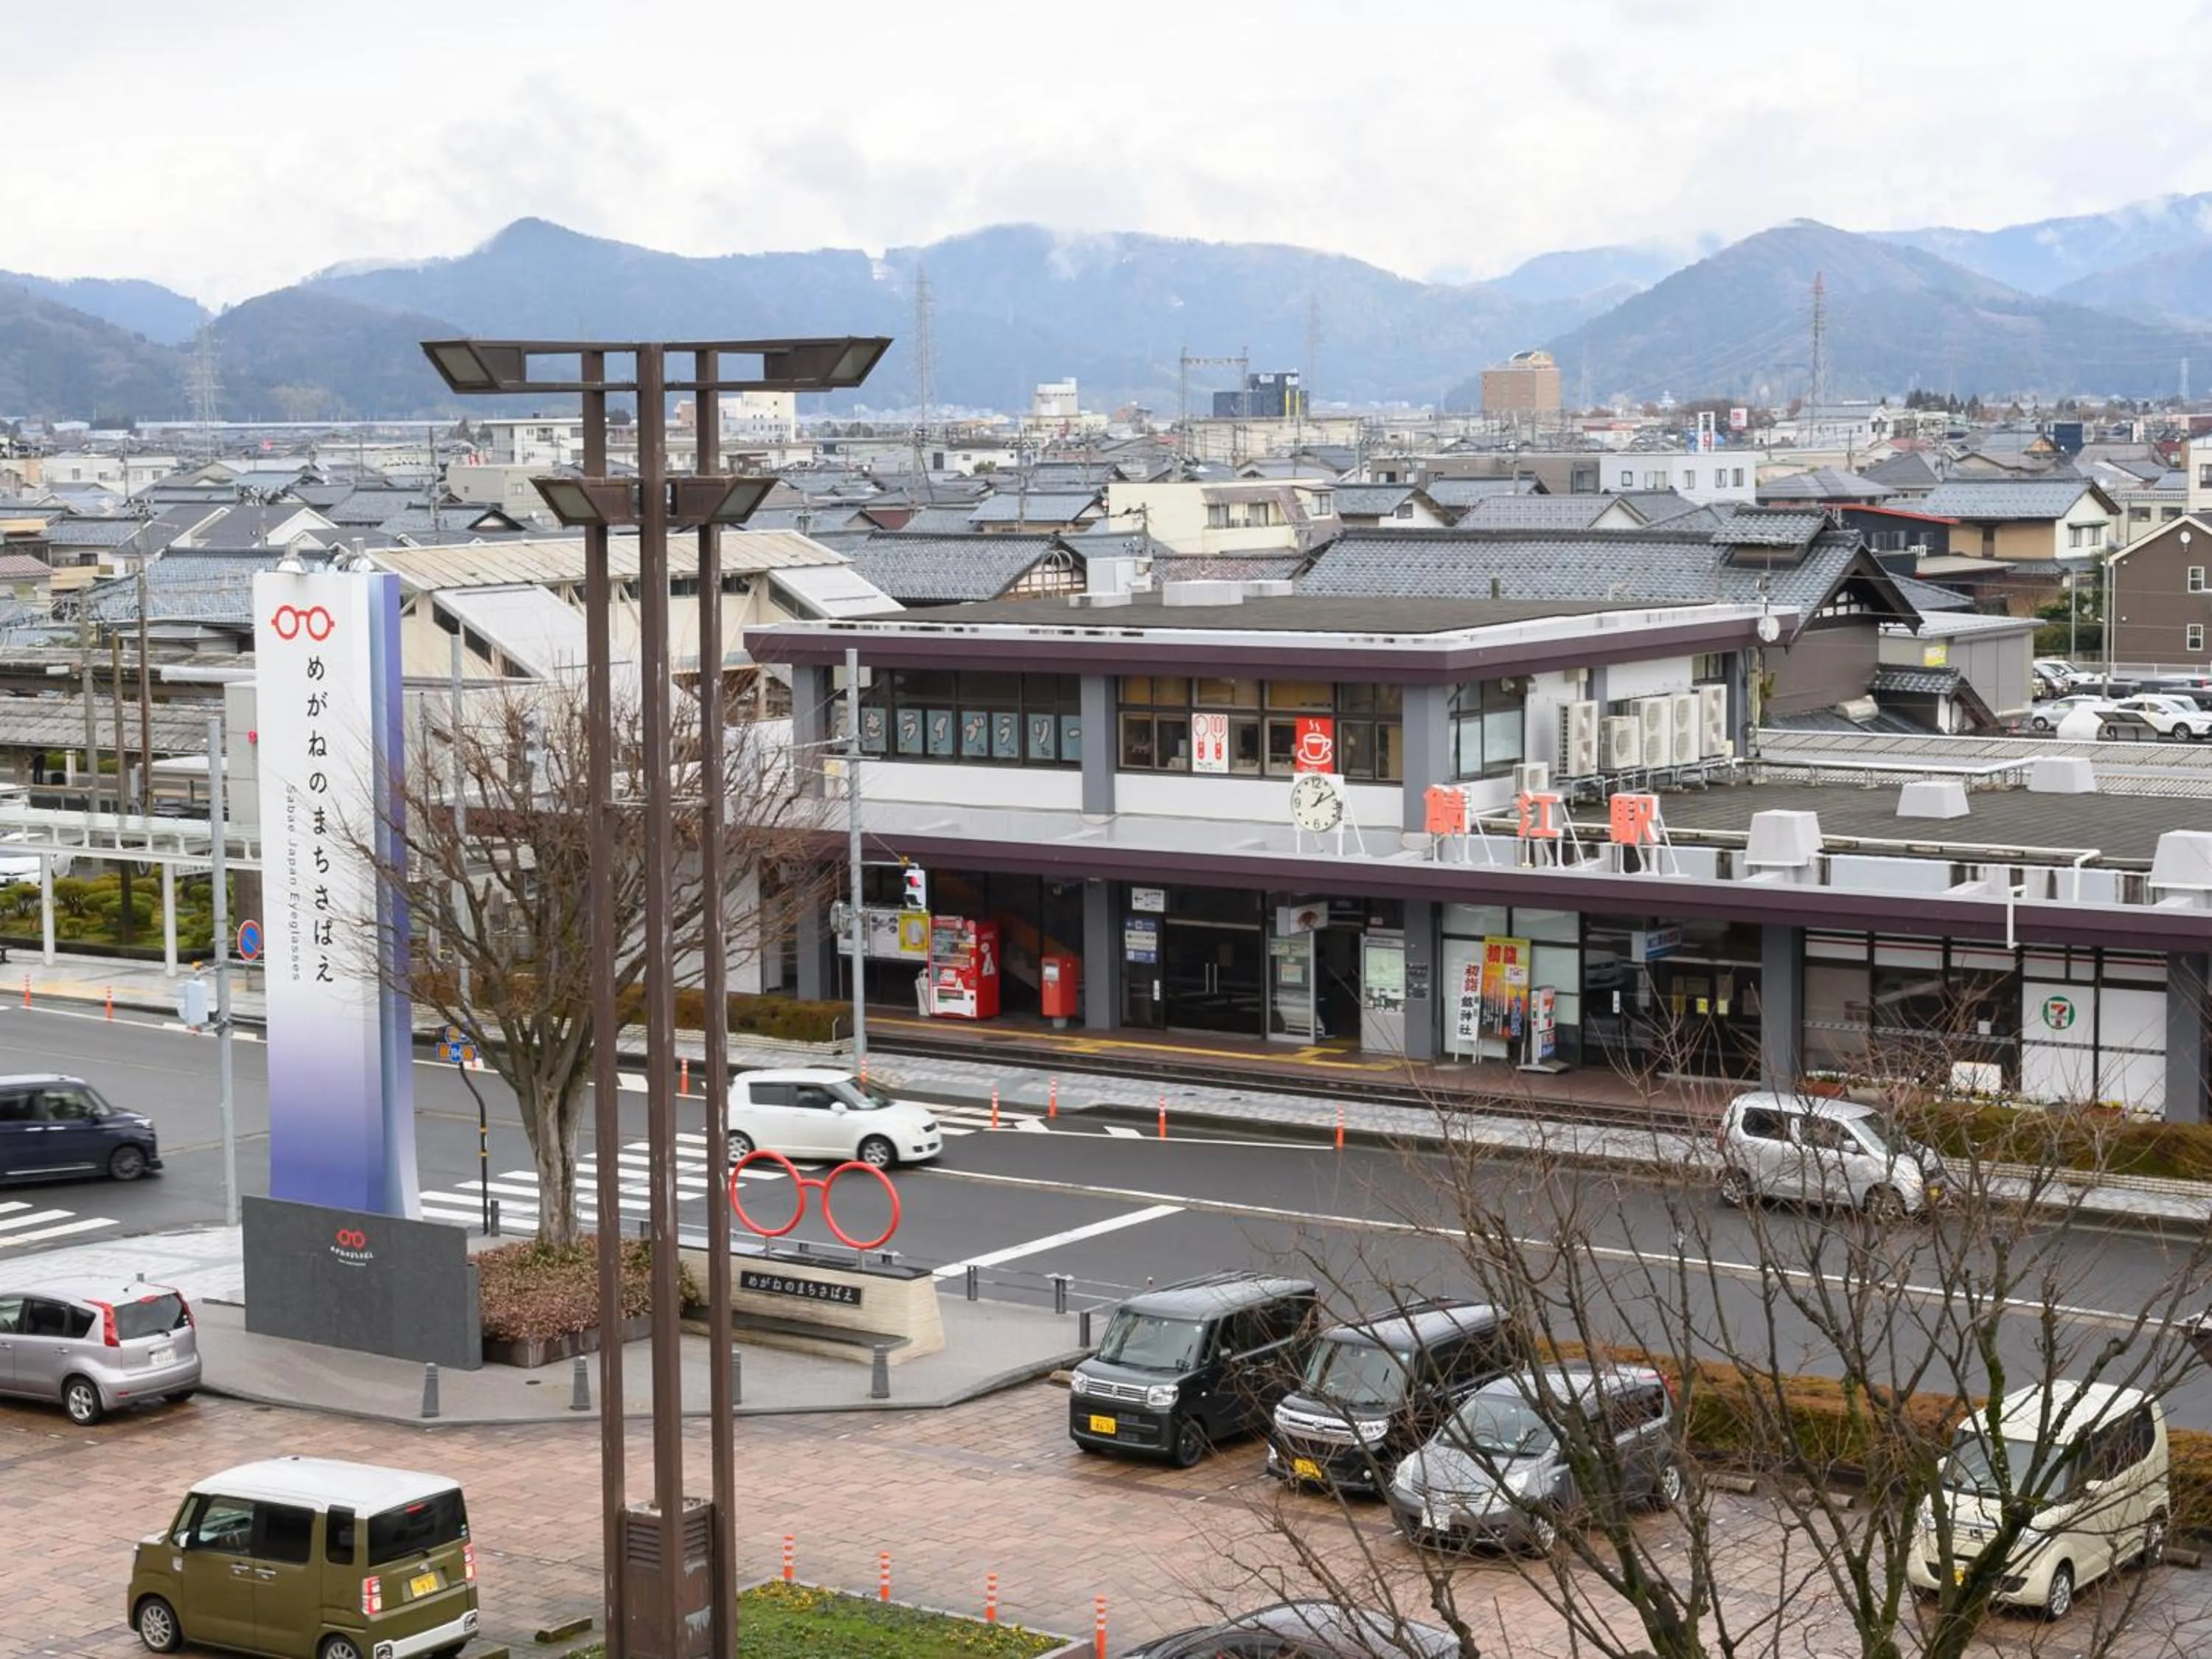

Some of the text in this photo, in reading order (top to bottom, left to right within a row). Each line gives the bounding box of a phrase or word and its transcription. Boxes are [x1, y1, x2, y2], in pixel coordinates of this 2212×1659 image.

[1312, 778, 1321, 789] 12
[1294, 797, 1301, 808] 9
[1424, 785, 1659, 845] 鯖江駅
[307, 655, 333, 983] めがねのまちさばえ
[1313, 818, 1320, 829] 6
[286, 784, 301, 981] Sabae Japan Eyeglasses
[748, 1275, 853, 1301] めがねのまちさばえ
